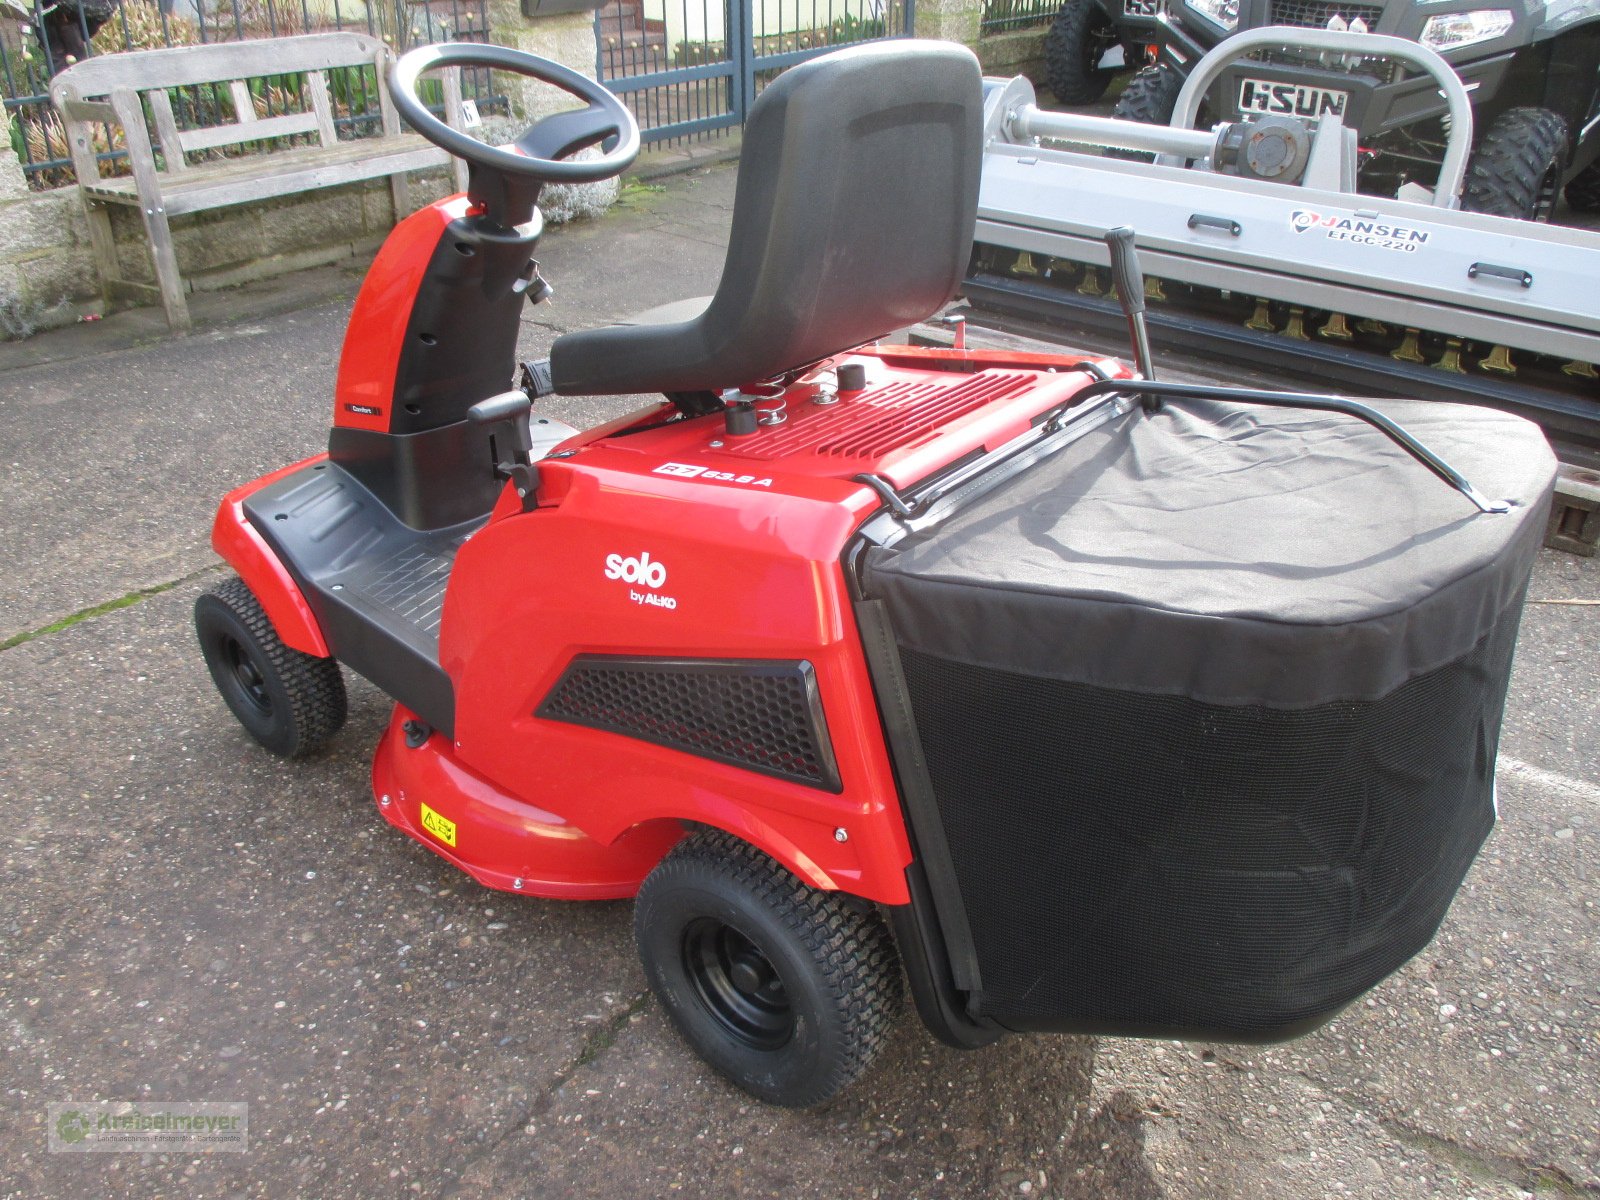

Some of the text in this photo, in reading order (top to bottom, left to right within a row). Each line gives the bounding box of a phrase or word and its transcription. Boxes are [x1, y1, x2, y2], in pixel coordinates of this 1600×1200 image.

[1321, 217, 1429, 243] JANSEN
[1327, 230, 1416, 252] EFGC-220
[352, 405, 372, 414] Comfort
[752, 478, 773, 487] A
[604, 551, 667, 588] solo
[630, 588, 645, 604] by
